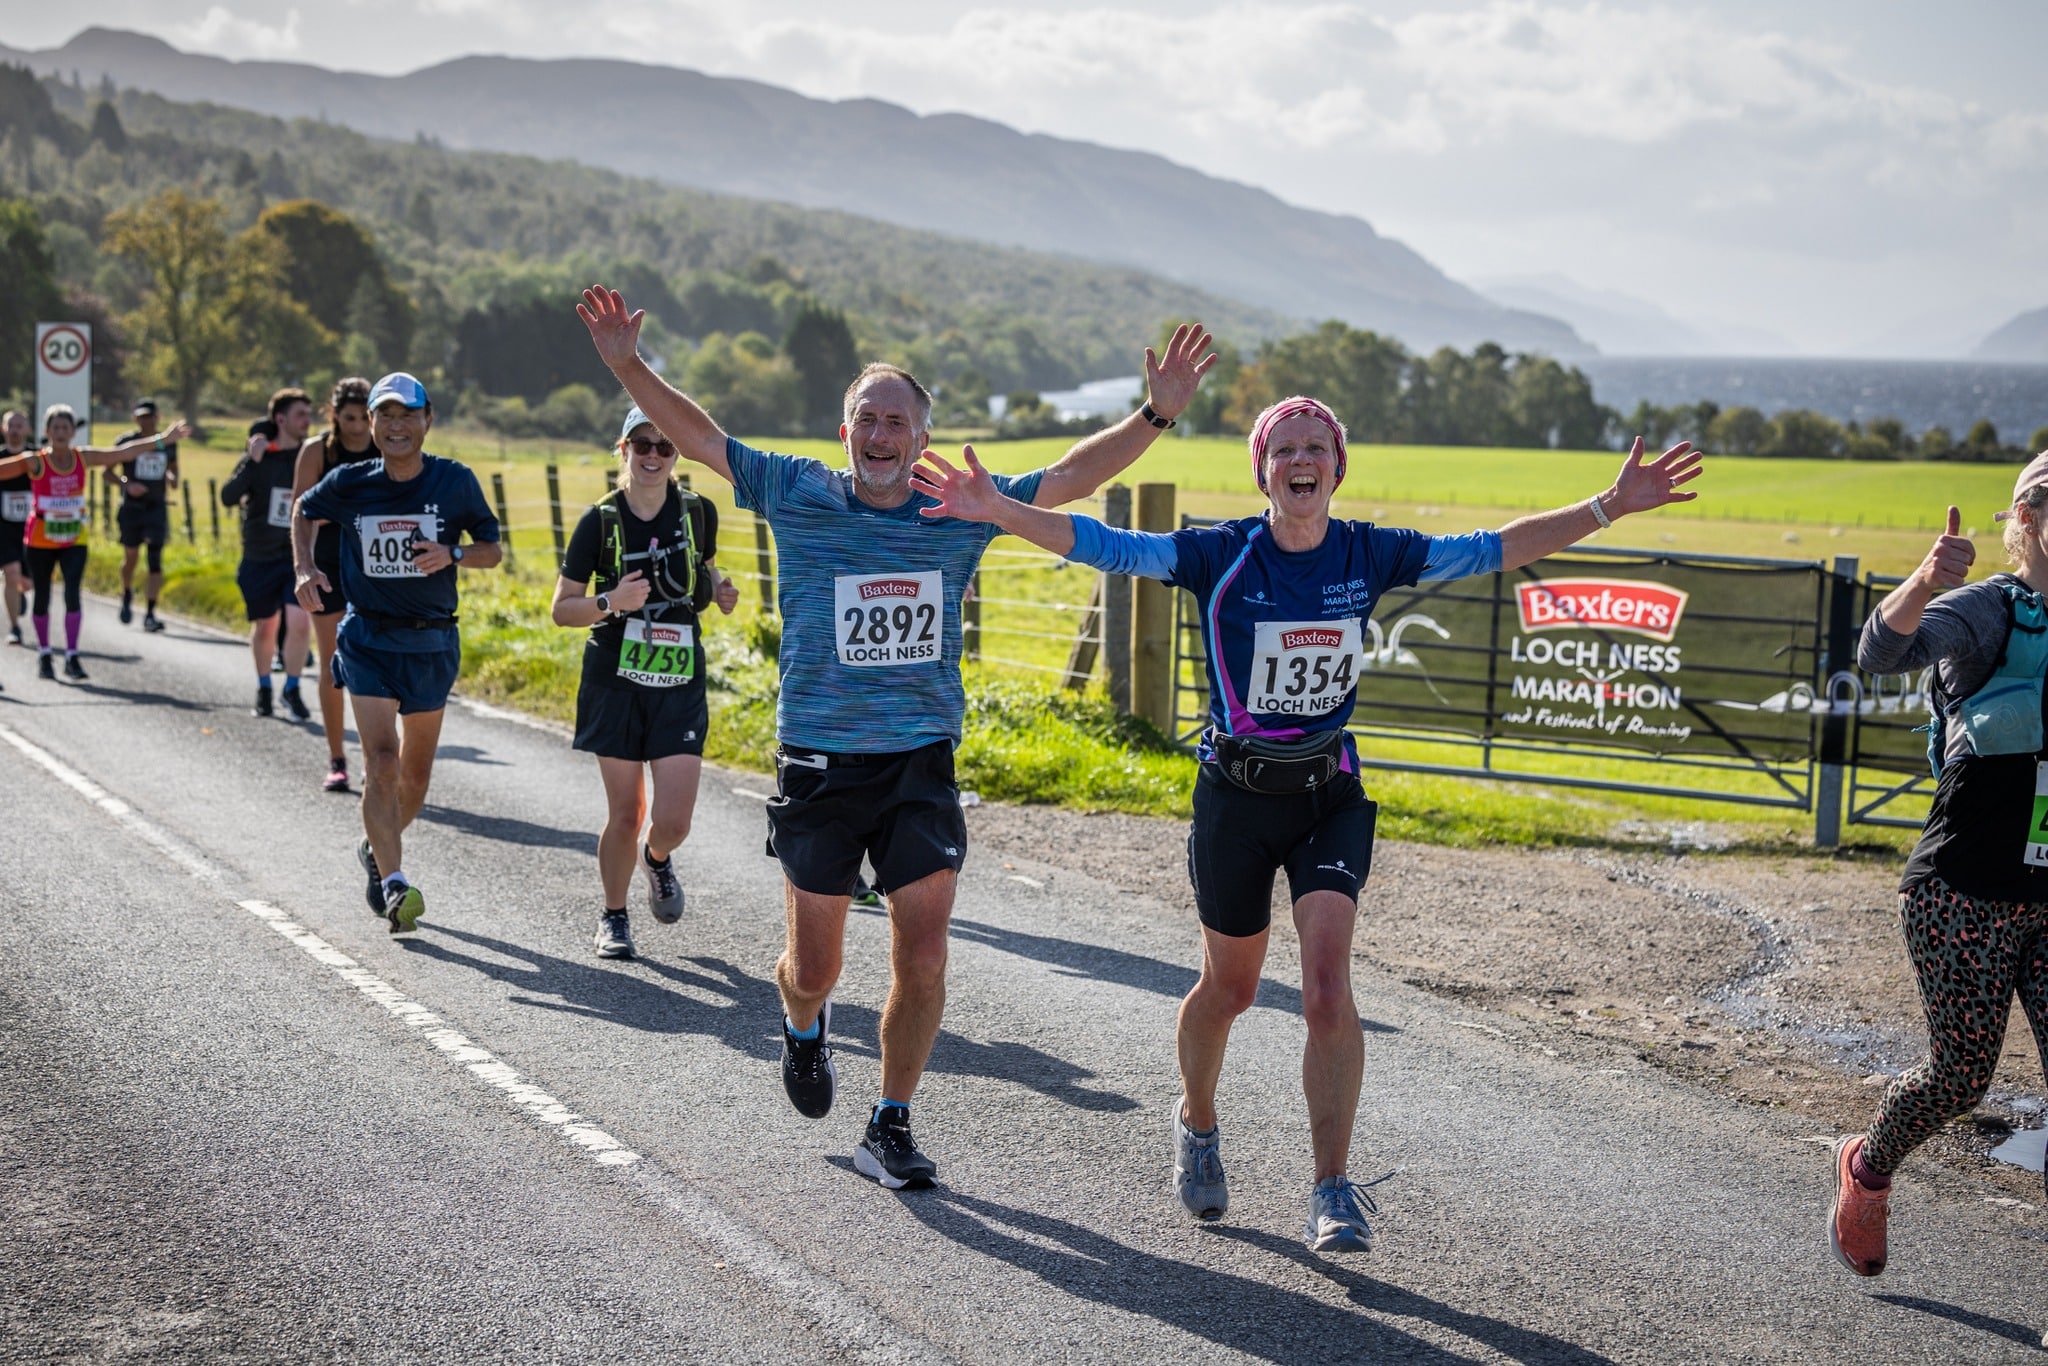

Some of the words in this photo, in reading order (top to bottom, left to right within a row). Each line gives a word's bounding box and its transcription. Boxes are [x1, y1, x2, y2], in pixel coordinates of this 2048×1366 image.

[49, 340, 81, 361] 20
[369, 538, 415, 563] 408
[370, 565, 399, 574] LOCH
[404, 565, 423, 574] NE
[863, 582, 917, 598] Baxters
[1528, 588, 1670, 629] Baxters
[645, 630, 679, 641] axters
[844, 603, 936, 645] 2892
[1285, 630, 1340, 647] Baxters
[625, 642, 690, 675] 4759
[846, 648, 890, 661] LOCH
[896, 644, 934, 660] NESS
[1511, 636, 1600, 668] LOCH
[1609, 643, 1682, 673] NESS
[1265, 653, 1354, 697] 1354
[1257, 697, 1304, 712] LOCH
[1511, 675, 1682, 711] MARATHON
[1502, 706, 1533, 724] and
[1535, 708, 1596, 730] Festival
[1604, 714, 1625, 735] of
[1625, 715, 1692, 743] Running
